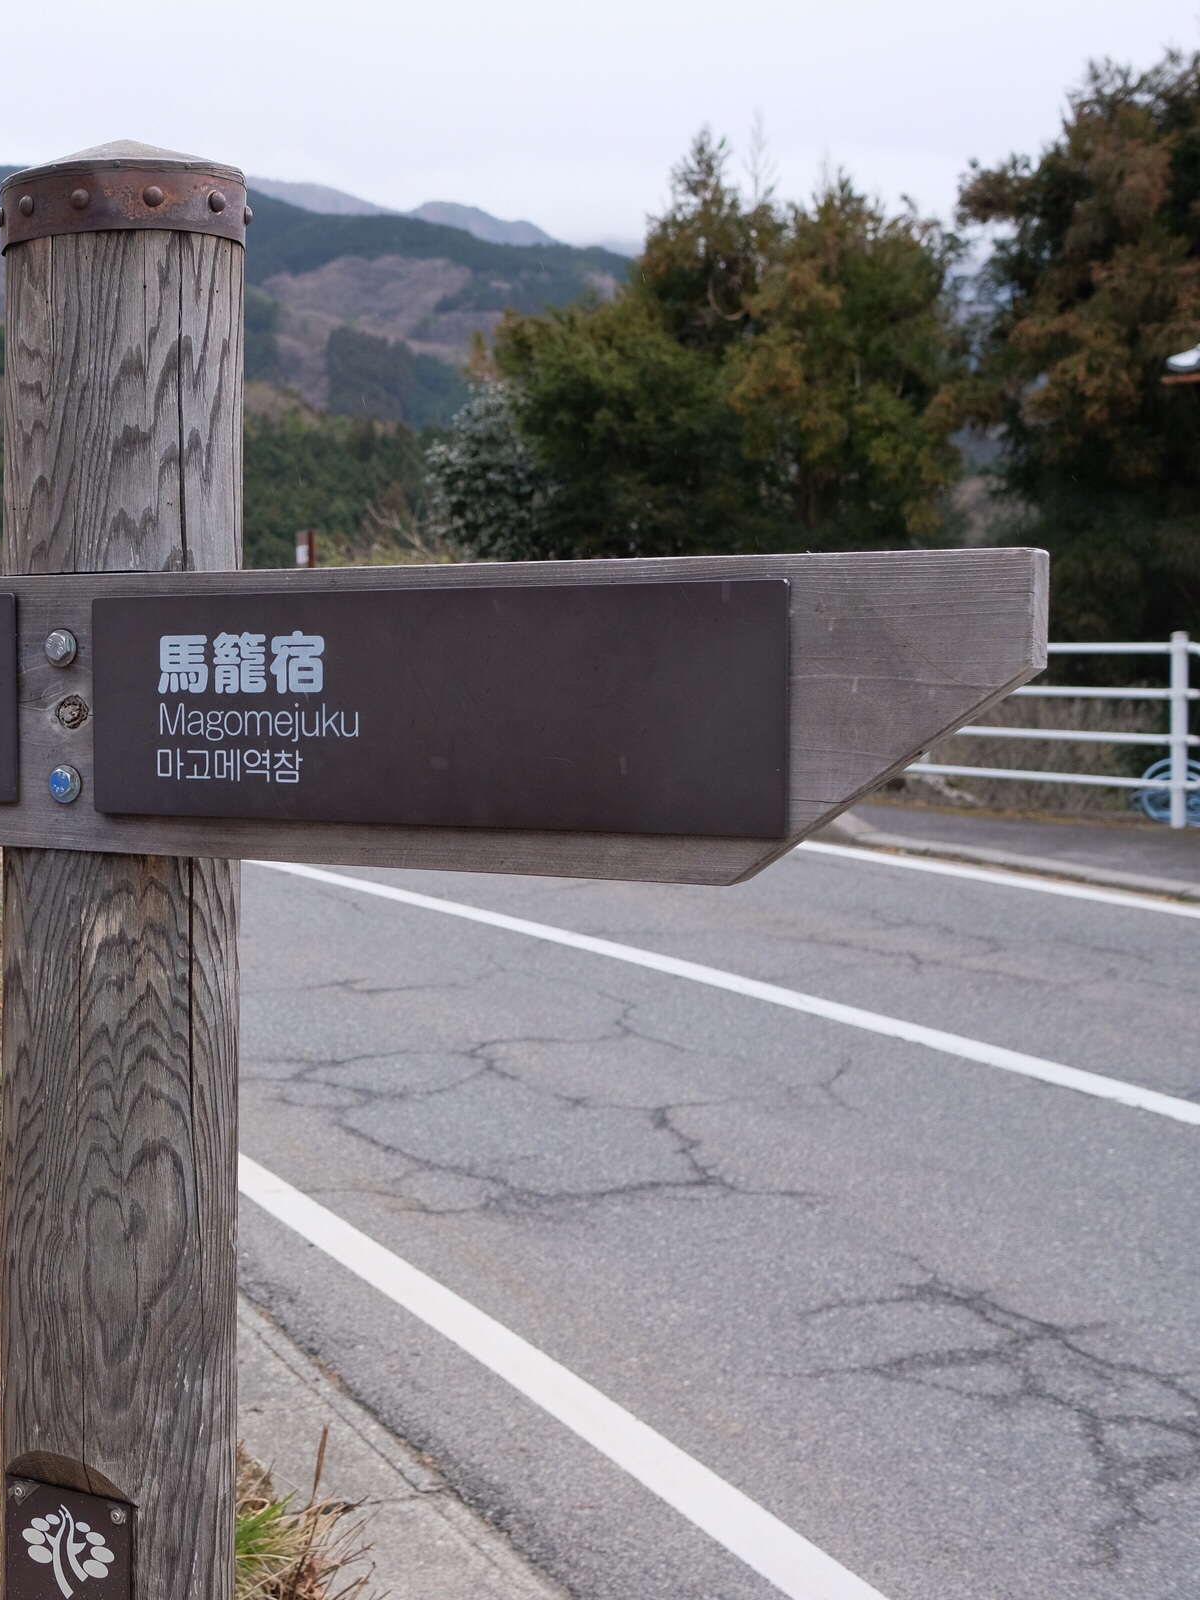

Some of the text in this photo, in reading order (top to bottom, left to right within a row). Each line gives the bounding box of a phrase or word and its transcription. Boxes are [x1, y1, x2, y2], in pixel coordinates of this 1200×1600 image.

[157, 630, 325, 694] 馬籠宿
[159, 702, 359, 743] Magomejuku
[156, 747, 304, 784] 마고메역참
